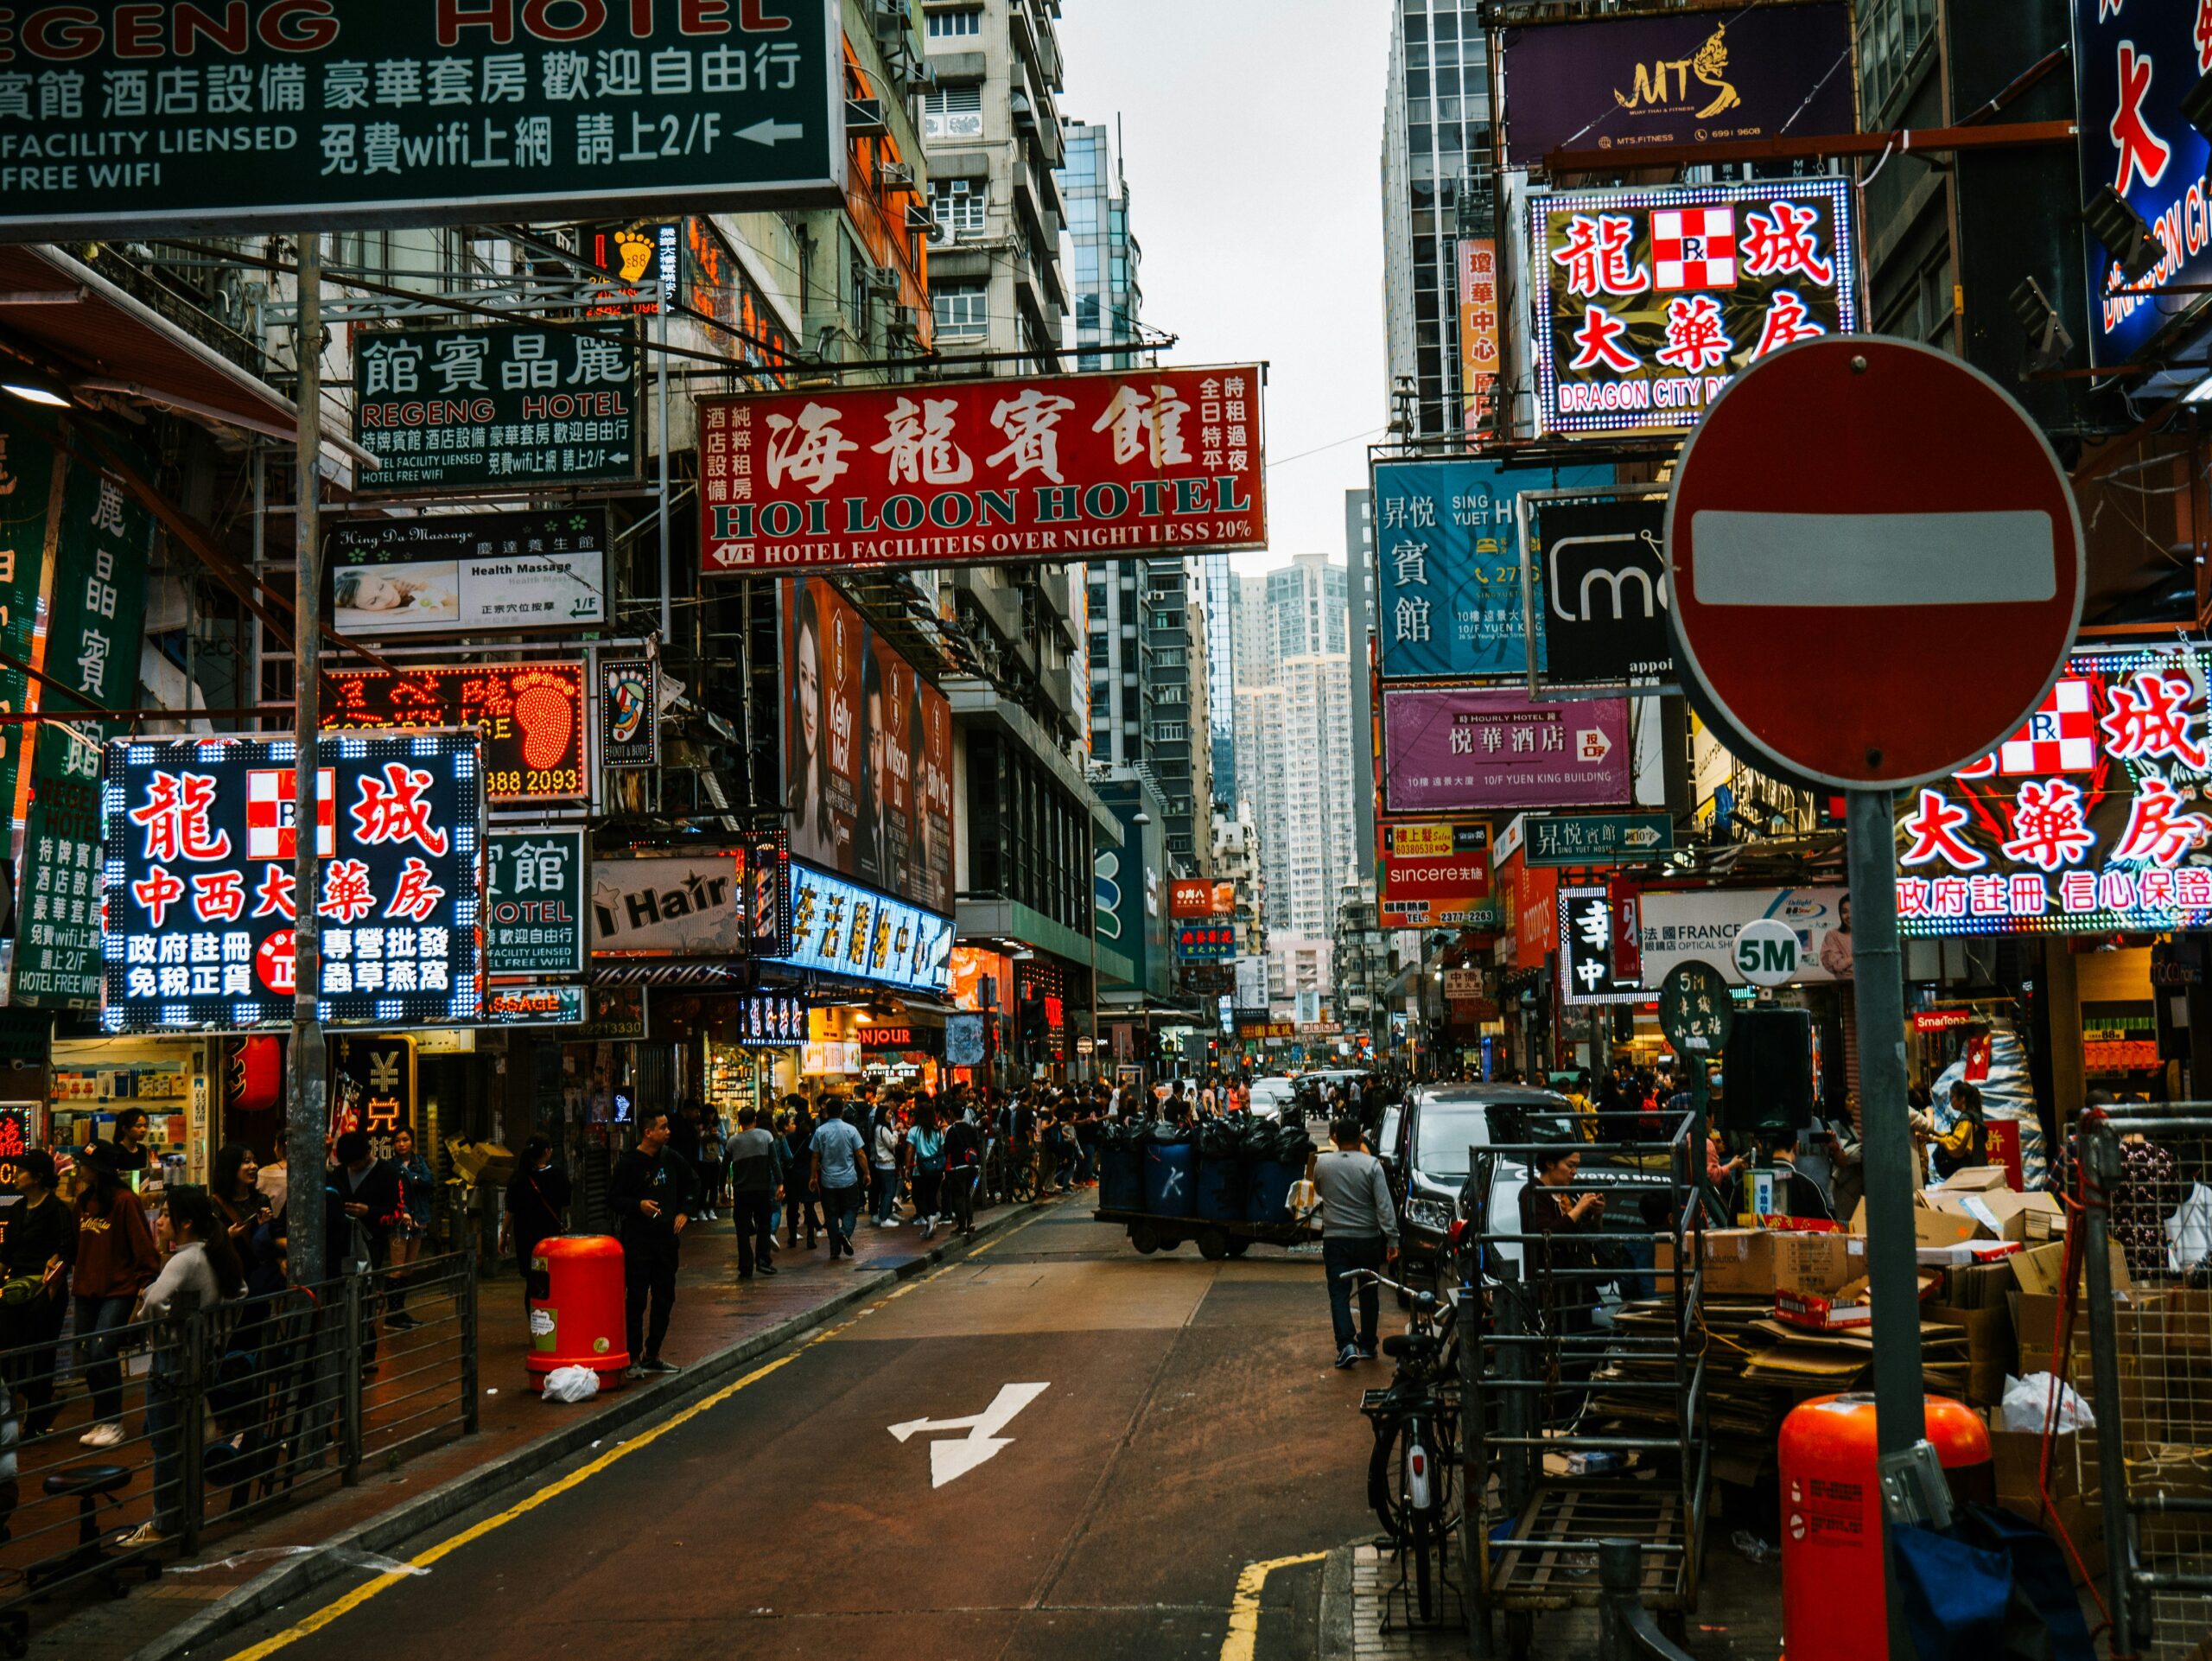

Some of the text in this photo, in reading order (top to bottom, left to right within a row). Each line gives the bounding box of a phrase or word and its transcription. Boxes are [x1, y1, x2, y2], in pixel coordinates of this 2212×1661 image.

[0, 0, 792, 62] GENG HOTEL
[103, 63, 306, 118] 酒店設備
[324, 53, 527, 110] 豪華套房
[542, 42, 800, 101] 歡迎自由行
[1614, 21, 1741, 119] MTS
[2, 126, 297, 159] FACILITY LIENSED
[1617, 134, 1674, 145] MTS.FITNESS
[2, 162, 161, 191] FREE WIFI
[1552, 200, 1833, 297] 龍 城
[1559, 381, 1648, 412] DRAGON
[1652, 379, 1702, 407] CITY
[361, 391, 629, 428] REGENG HOTEL
[425, 426, 486, 449] 酒店設備
[490, 423, 550, 448] 豪華套房
[554, 418, 629, 444] 歡迎自由行
[1224, 375, 1249, 473] 時租過夜
[766, 385, 1192, 495] 海龍賓館
[397, 455, 441, 468] FACILITY
[442, 453, 483, 466] LIENSED
[707, 407, 728, 502] 酒店設備
[361, 469, 443, 484] HOTEL FREE WIFI
[710, 475, 1251, 540] HOI LOON HOTEL
[1452, 494, 1489, 510] SING
[1452, 511, 1489, 526] YUET
[382, 527, 476, 544] Da Massage
[722, 519, 1252, 563] 1/F HOTEL FACILITEIS OVER NIGHT LESS 20%
[471, 562, 572, 576] Health Massage
[574, 597, 597, 610] 1/F
[1458, 623, 1513, 633] 10/F YUEN
[1629, 658, 1674, 672] appoi
[830, 688, 852, 745] Kelly
[1471, 715, 1510, 724] HOURLY
[1513, 713, 1545, 723] HOTEL
[2101, 672, 2208, 772] 城
[609, 745, 625, 757] FOOT
[632, 744, 648, 756] BODY
[832, 737, 849, 775] Mok
[886, 730, 908, 782] Wilson
[527, 769, 577, 792] 2093
[893, 775, 903, 808] Liu
[927, 760, 950, 817] Billy Ng
[1484, 775, 1503, 786] 10/F
[1507, 773, 1534, 785] YUEN
[1537, 773, 1561, 784] KING
[1564, 772, 1611, 783] BUILDING
[130, 761, 448, 862] 龍 城
[1900, 778, 2203, 870] 大藥房
[1390, 867, 1483, 882] sincere 先施
[489, 900, 573, 924] OTEL
[624, 869, 728, 930] Hair
[127, 931, 252, 964] 政府註冊
[489, 947, 571, 958] FACILITY LIENSED
[1678, 940, 1717, 951] OPTICAL
[1738, 939, 1796, 972] 5M
[505, 958, 537, 967] FREE
[540, 957, 571, 966] WIFI
[19, 971, 80, 993] HOTEL FREE
[1680, 972, 1705, 992] 5M
[489, 995, 560, 1012] SSAGE
[1917, 1015, 1967, 1028] SmarTone
[855, 1028, 912, 1044] ONJOUR
[1632, 1174, 1671, 1183] SPOR
